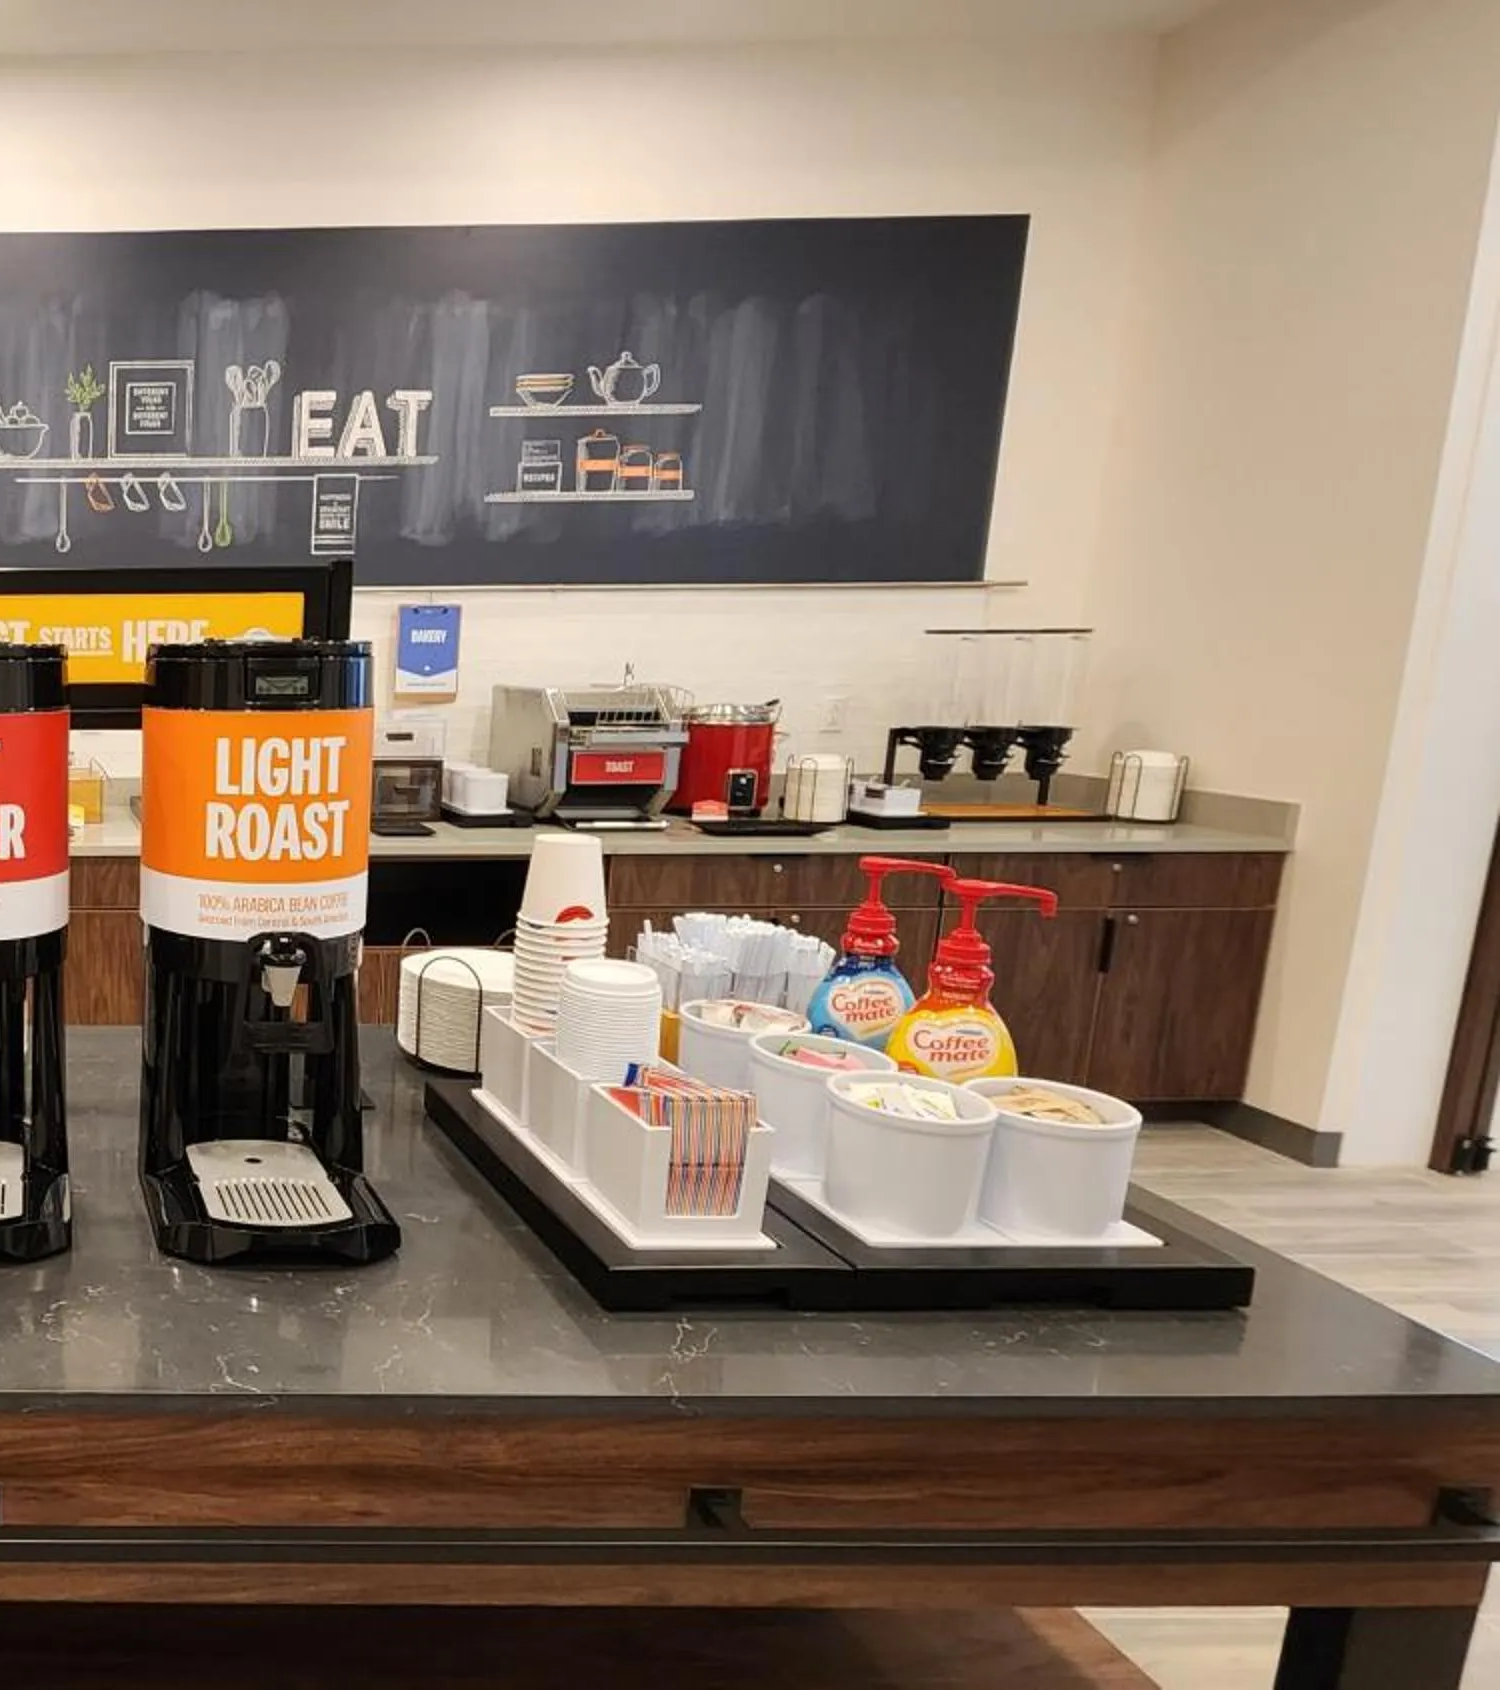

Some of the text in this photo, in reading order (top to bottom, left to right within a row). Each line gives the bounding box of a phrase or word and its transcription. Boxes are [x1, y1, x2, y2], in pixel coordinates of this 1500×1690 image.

[292, 390, 433, 460] EAT
[39, 626, 112, 649] STARTS
[215, 735, 347, 797] LIGHT
[205, 799, 350, 861] ROAST
[233, 896, 285, 913] ARABICA
[289, 896, 317, 912] BEAN
[831, 993, 893, 1012] Coffee
[844, 1006, 896, 1023] mate
[913, 1029, 989, 1051] Coffee
[929, 1047, 991, 1062] mate
